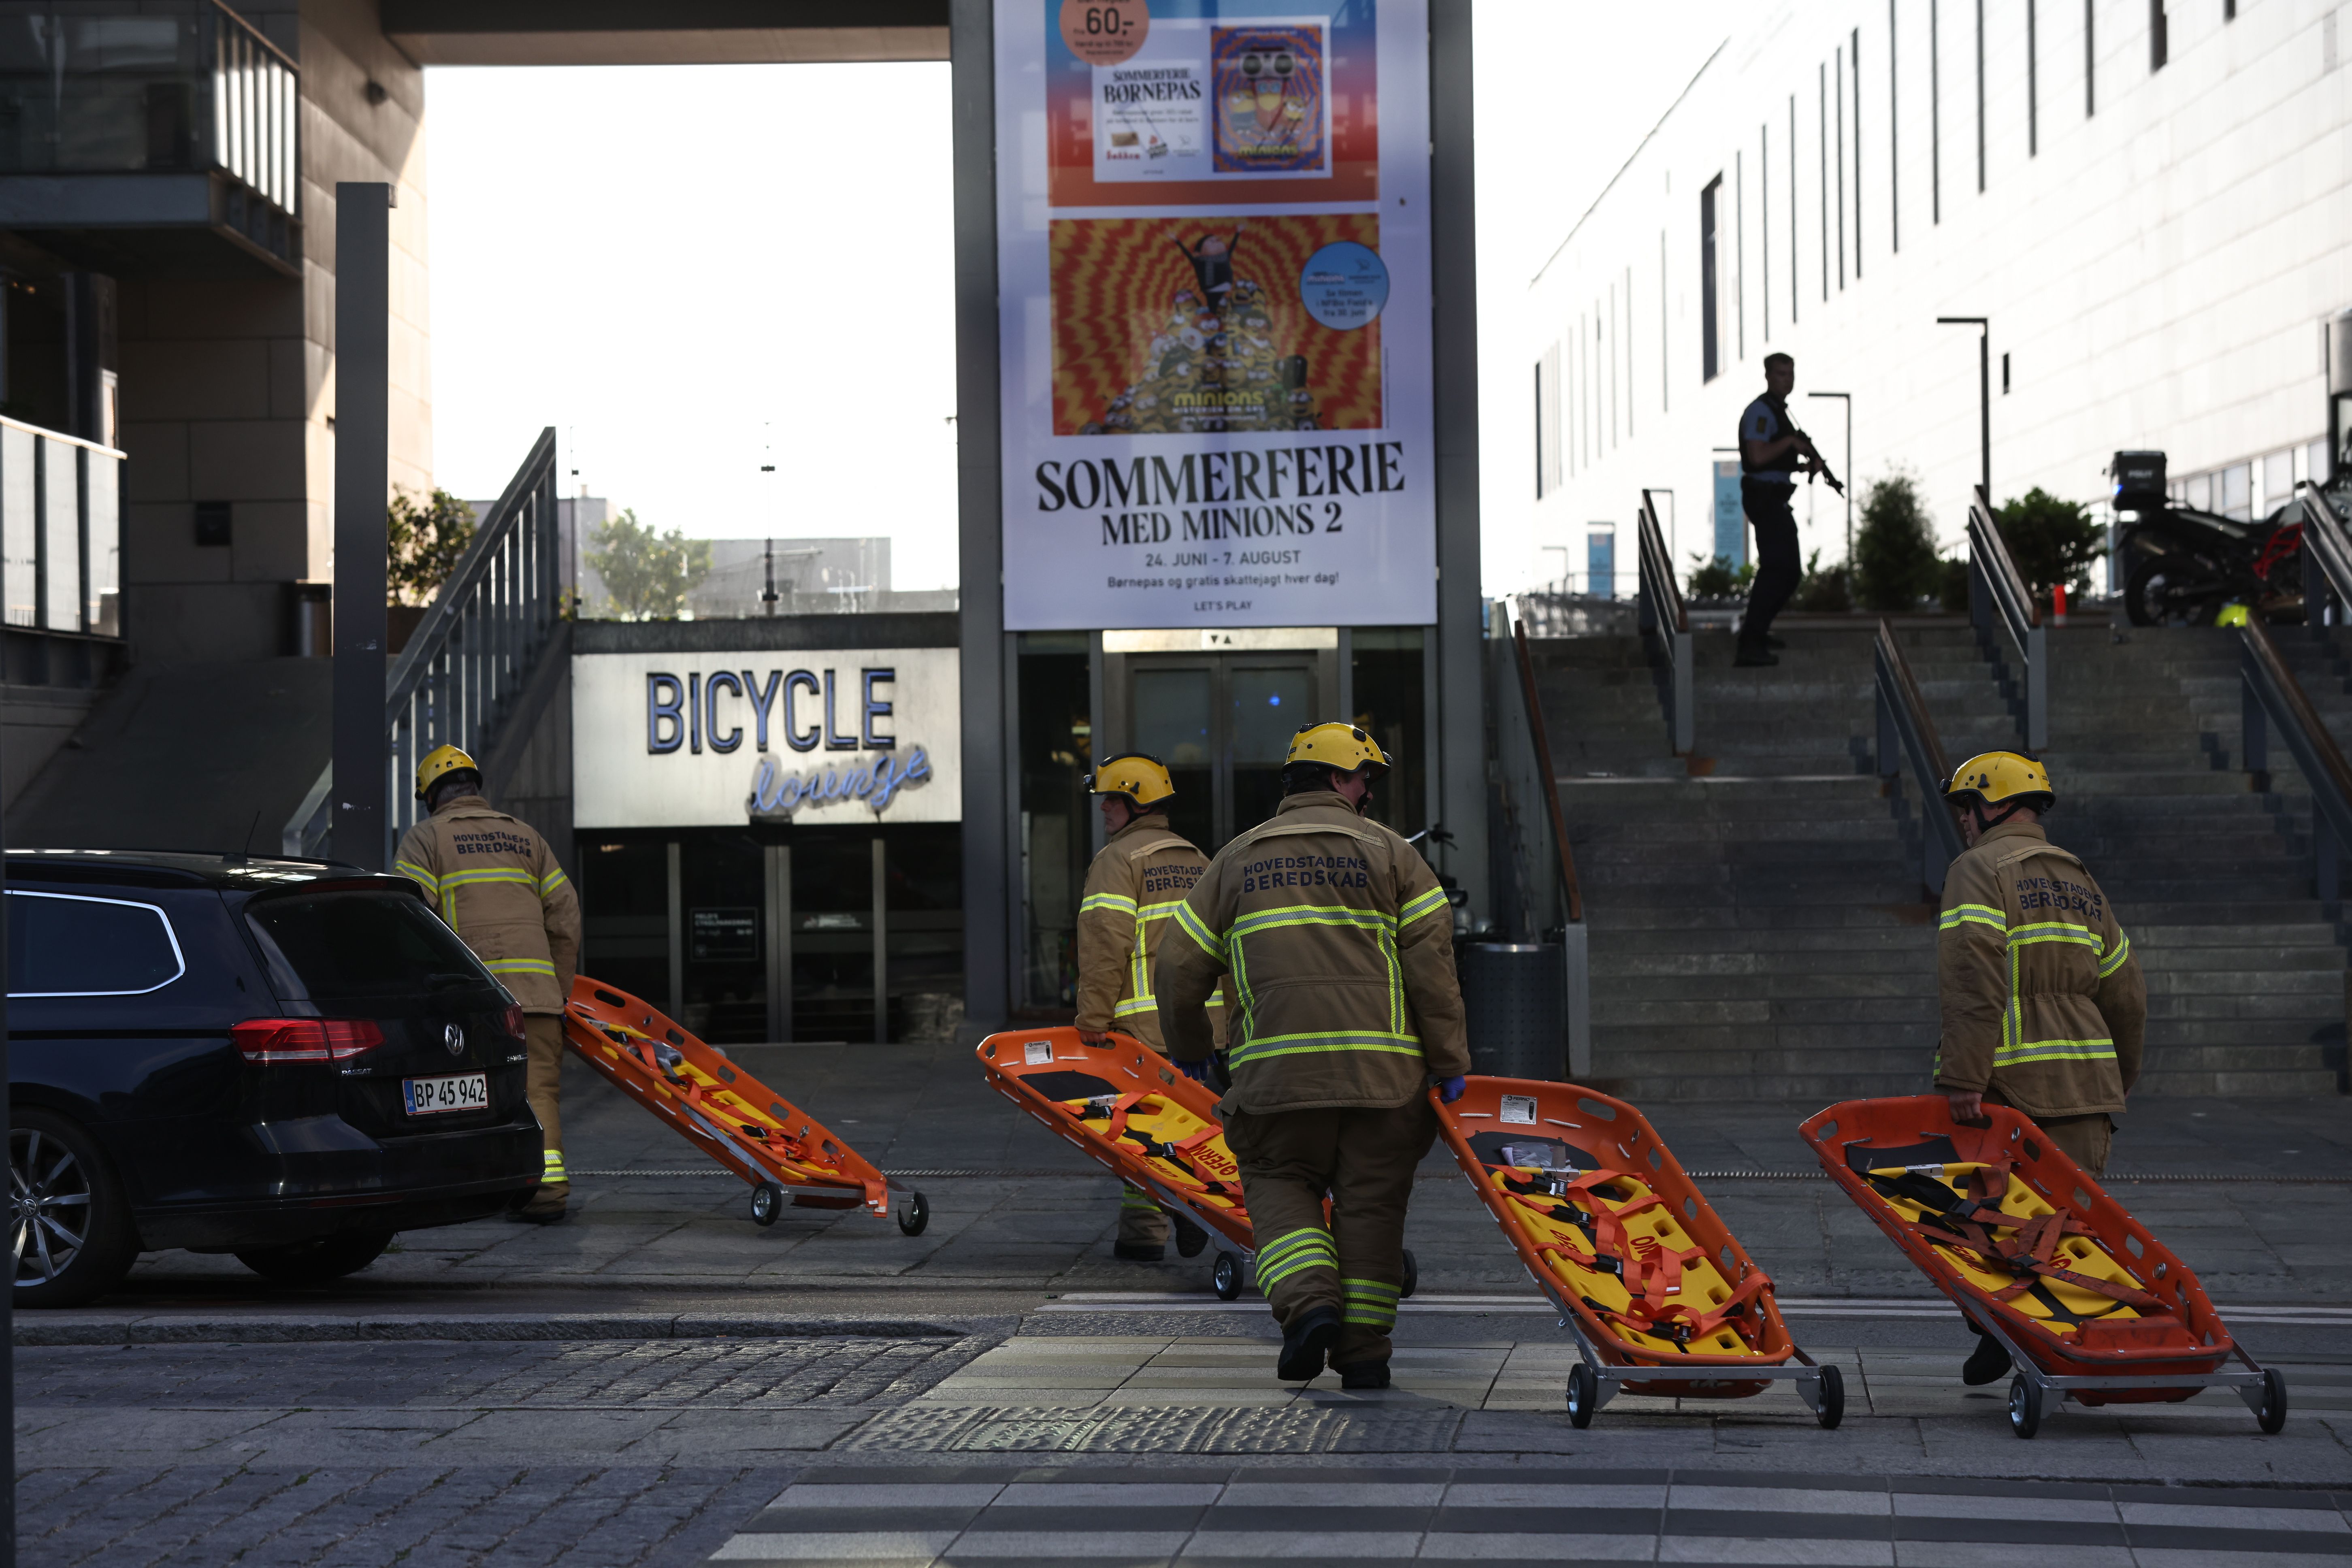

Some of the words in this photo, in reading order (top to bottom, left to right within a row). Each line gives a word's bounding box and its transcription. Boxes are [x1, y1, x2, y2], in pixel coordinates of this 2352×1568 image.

[1114, 68, 1190, 81] SOMMERFERIE
[1174, 390, 1265, 406] minions
[1035, 441, 1405, 511] SOMMERFERIE
[1102, 512, 1171, 545] MED
[1182, 502, 1314, 541] MINIONS
[1325, 501, 1343, 533] 2
[1172, 552, 1207, 567] JUNI
[1240, 550, 1301, 565] AUGUST
[1108, 576, 1164, 589] Børnepas
[1167, 578, 1182, 589] og
[1185, 575, 1220, 589] gratis
[1223, 573, 1281, 587] skattejagt
[1285, 573, 1311, 584] hver
[1225, 600, 1252, 611] PLAY
[646, 667, 896, 755] BICYCLE
[750, 748, 931, 812] lounge
[1143, 865, 1206, 878] HOVEDSTADE
[1244, 855, 1367, 877] HOVEDSTADENS
[1244, 870, 1368, 893] BEREDSKAB
[2016, 878, 2102, 905] HOVEDSTADENS
[415, 1083, 434, 1107] BP
[439, 1080, 456, 1105] 45
[459, 1078, 486, 1105] 942
[1190, 1145, 1231, 1170] FERN
